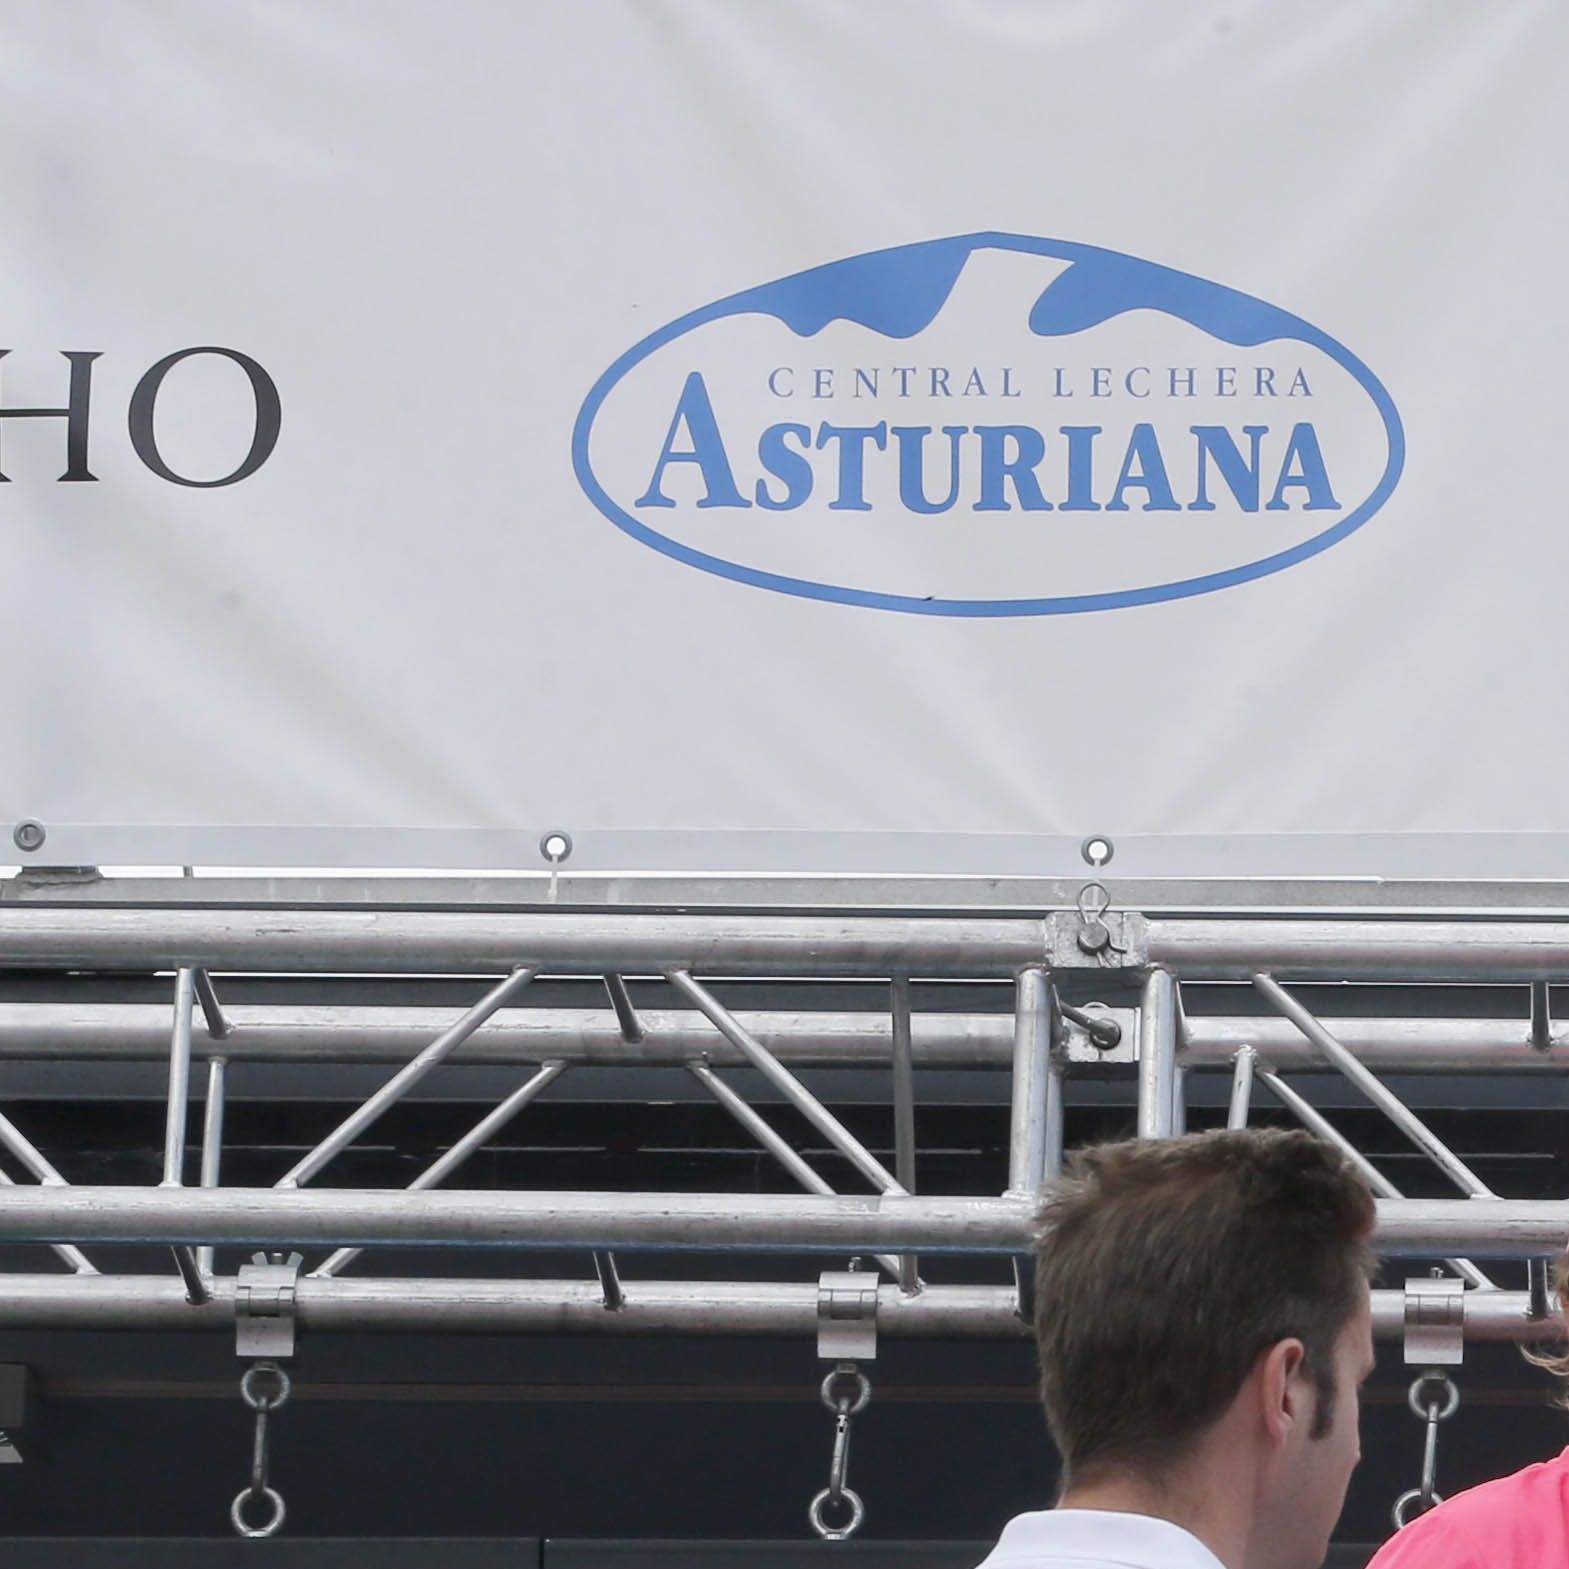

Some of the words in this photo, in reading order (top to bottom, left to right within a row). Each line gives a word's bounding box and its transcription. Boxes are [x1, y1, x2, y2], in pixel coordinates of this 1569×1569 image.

[768, 366, 1024, 400] CENTRAL
[1051, 366, 1316, 400] LECHERA
[634, 369, 1342, 515] ASTURIANA
